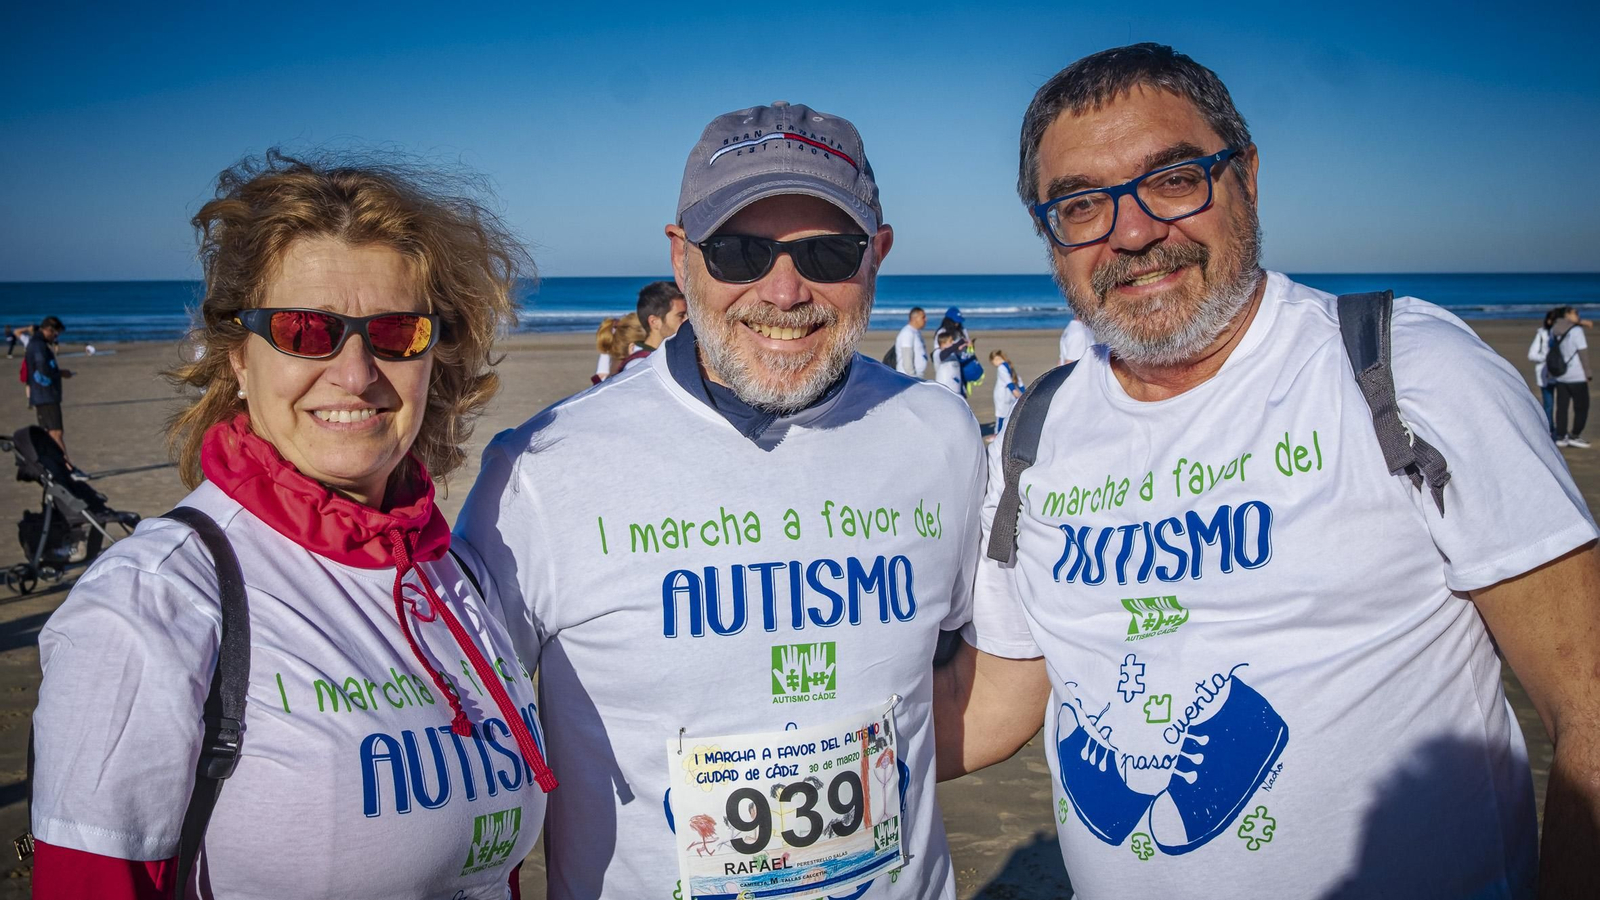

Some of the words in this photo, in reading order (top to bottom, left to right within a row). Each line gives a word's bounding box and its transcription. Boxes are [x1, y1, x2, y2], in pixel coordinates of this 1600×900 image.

[1041, 474, 1130, 518] marcha
[1139, 470, 1154, 501] a
[1172, 452, 1252, 498] favor
[1275, 430, 1323, 476] del
[597, 516, 608, 554] I
[629, 506, 761, 553] marcha
[783, 508, 801, 541] a
[820, 500, 900, 540] favor
[914, 499, 942, 540] del
[1052, 500, 1274, 586] AUTISMO
[661, 554, 919, 638] AUTISMO
[313, 667, 436, 713] marcha
[772, 694, 810, 704] AUTISMO
[812, 691, 837, 701] CÁDIZ
[705, 748, 756, 764] MARCHA
[762, 747, 772, 760] A
[777, 742, 816, 759] FAVOR
[820, 737, 841, 752] DEL
[808, 763, 819, 773] 30
[822, 760, 833, 770] de
[745, 768, 760, 780] de
[725, 770, 865, 855] 939
[724, 856, 793, 876] RAFAEL
